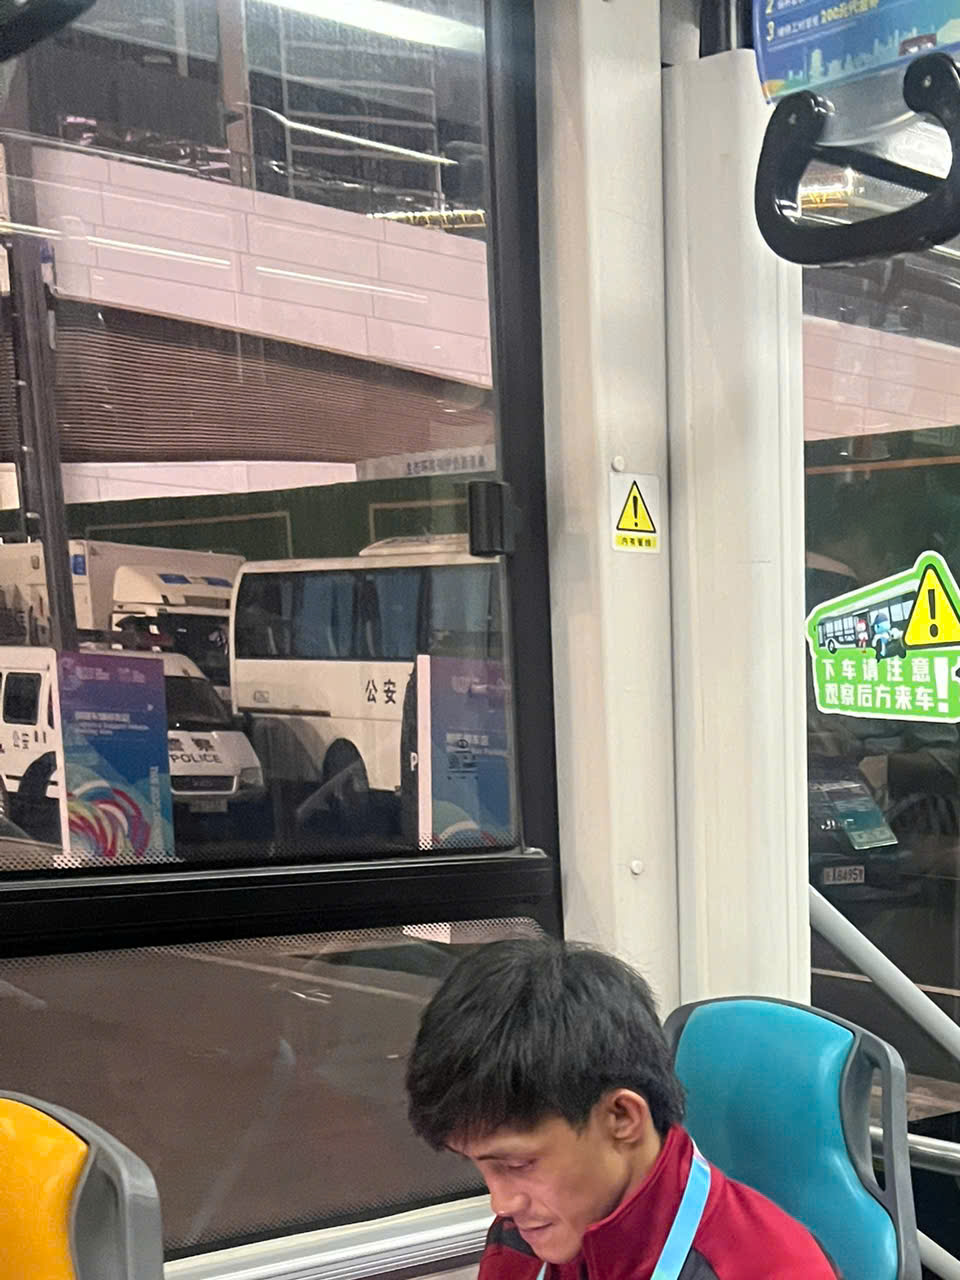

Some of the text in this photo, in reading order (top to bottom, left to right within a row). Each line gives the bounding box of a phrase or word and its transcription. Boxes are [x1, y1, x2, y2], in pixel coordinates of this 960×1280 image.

[766, 21, 775, 41] 3
[821, 657, 931, 683] 下车请注意
[365, 679, 397, 704] 公安
[824, 683, 934, 711] 观察后方来车
[170, 753, 223, 764] POLICE
